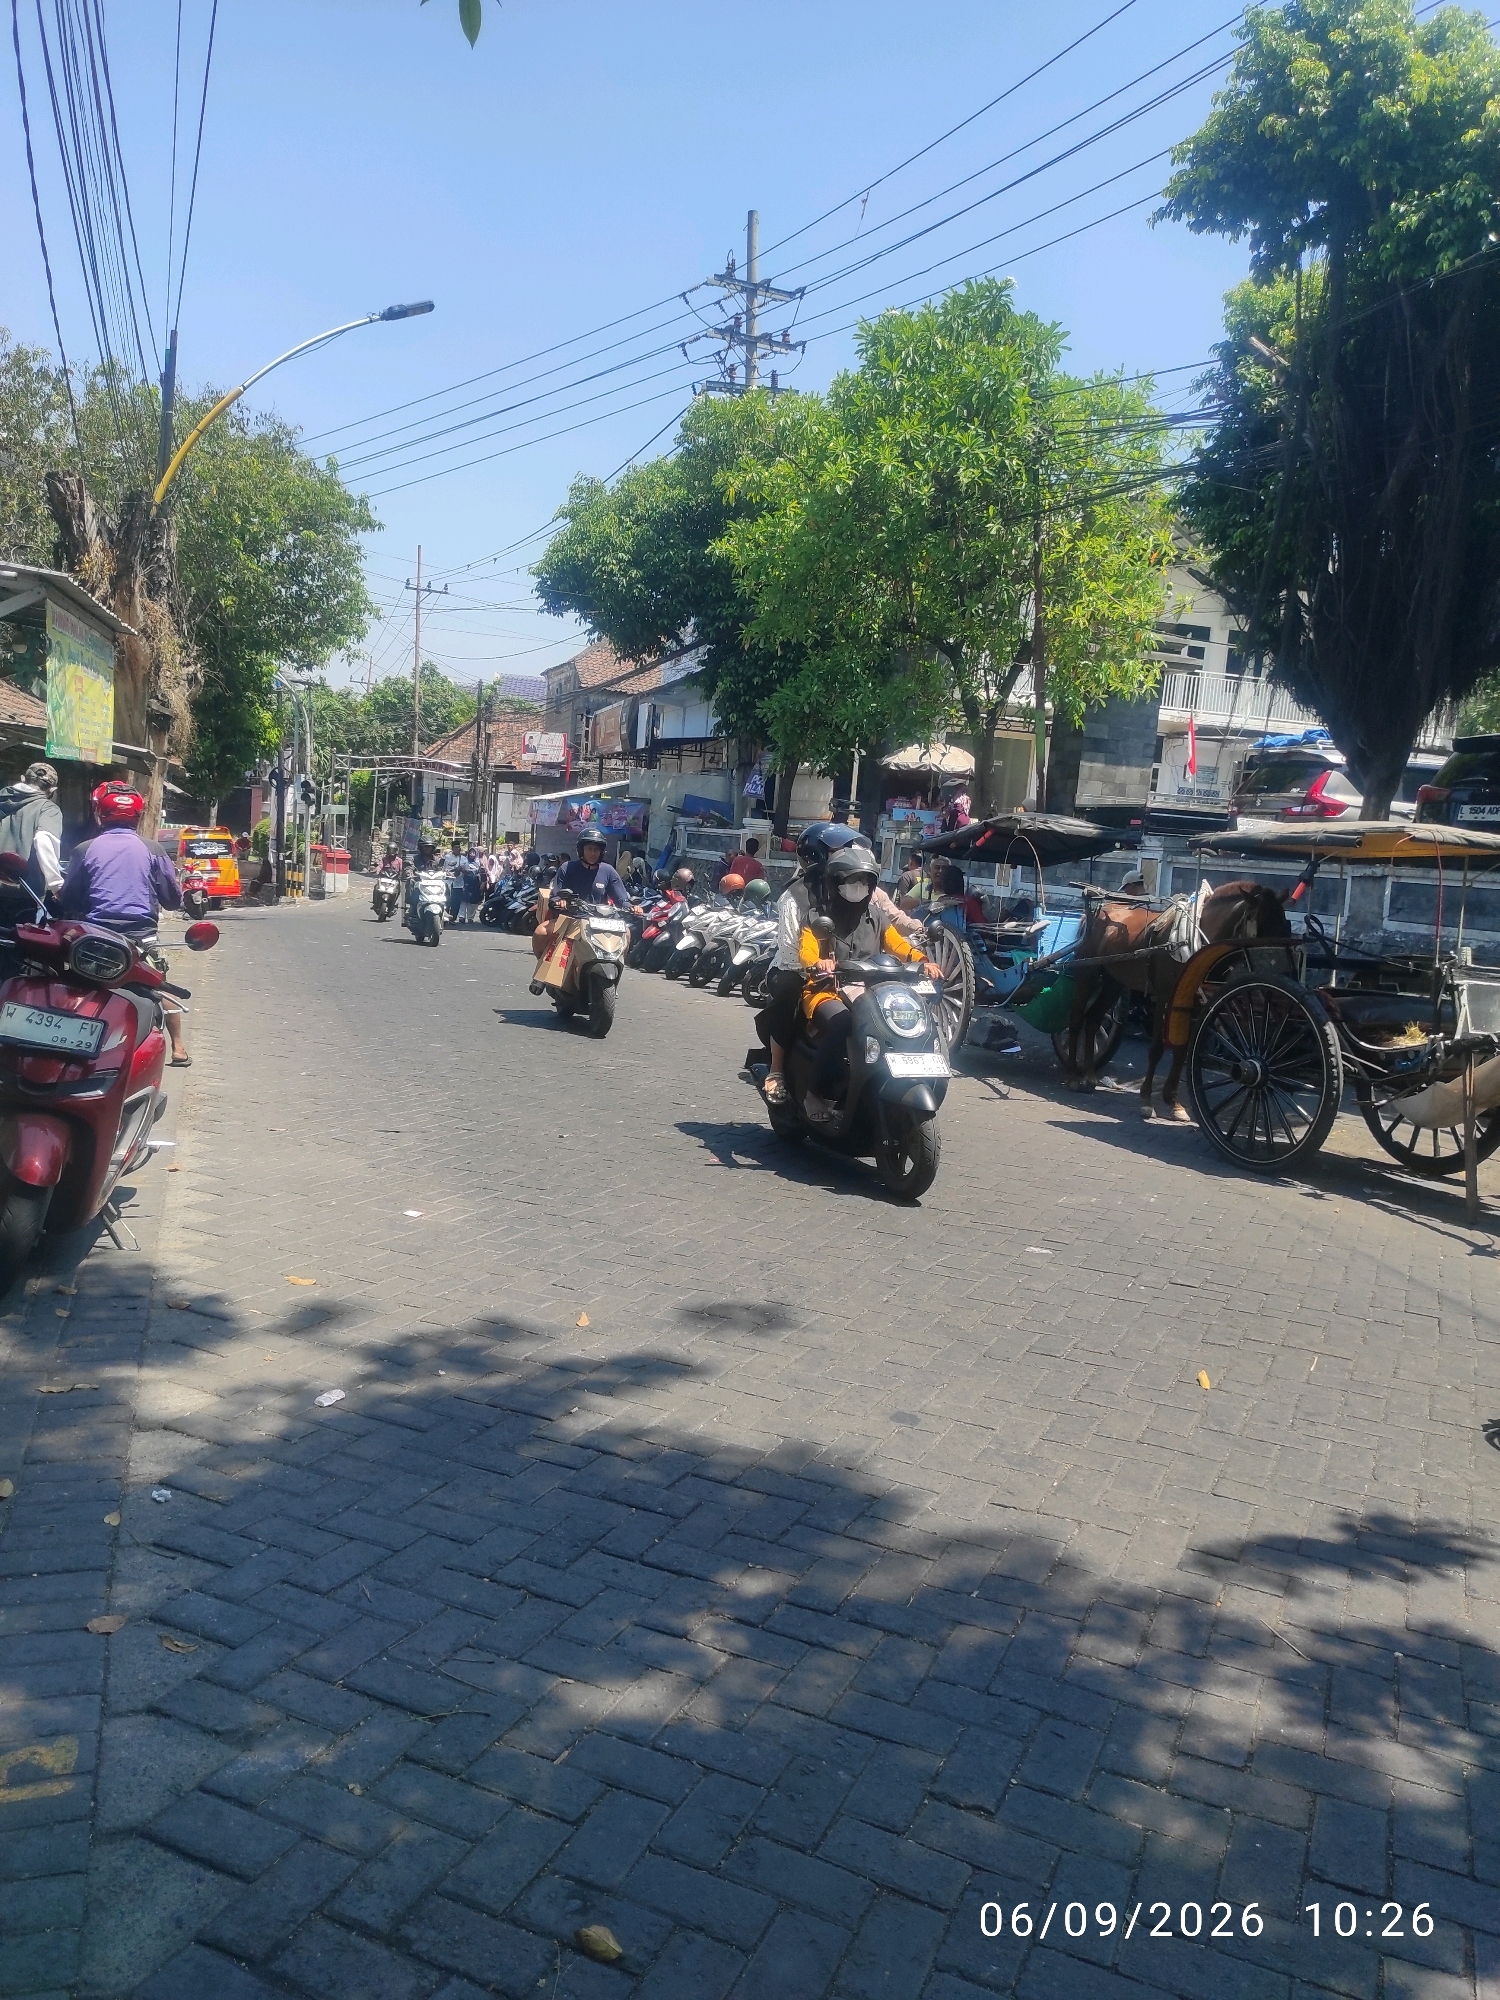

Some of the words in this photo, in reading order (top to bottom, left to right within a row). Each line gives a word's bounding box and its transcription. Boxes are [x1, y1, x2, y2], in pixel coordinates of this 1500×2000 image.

[1460, 806, 1465, 815] L
[1469, 806, 1486, 815] 1504
[6, 1005, 17, 1019] W
[25, 1011, 64, 1030] 4394
[79, 1022, 99, 1037] FV
